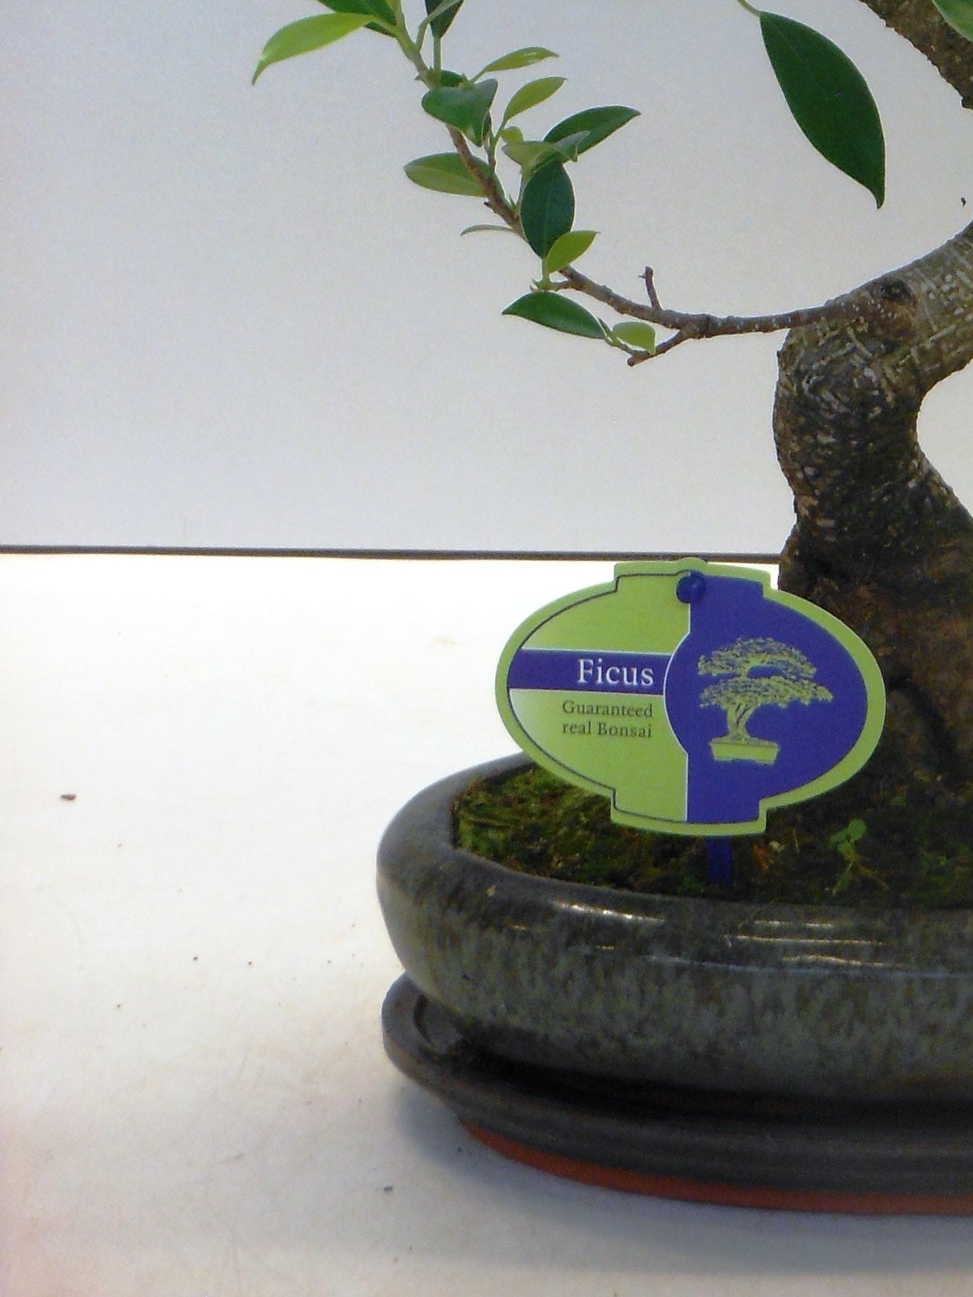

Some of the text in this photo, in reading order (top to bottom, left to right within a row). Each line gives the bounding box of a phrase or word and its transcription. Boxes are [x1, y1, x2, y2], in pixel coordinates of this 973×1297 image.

[577, 658, 654, 686] Ficus
[562, 700, 653, 718] Guaranteed
[562, 721, 652, 738] real Bonsai
